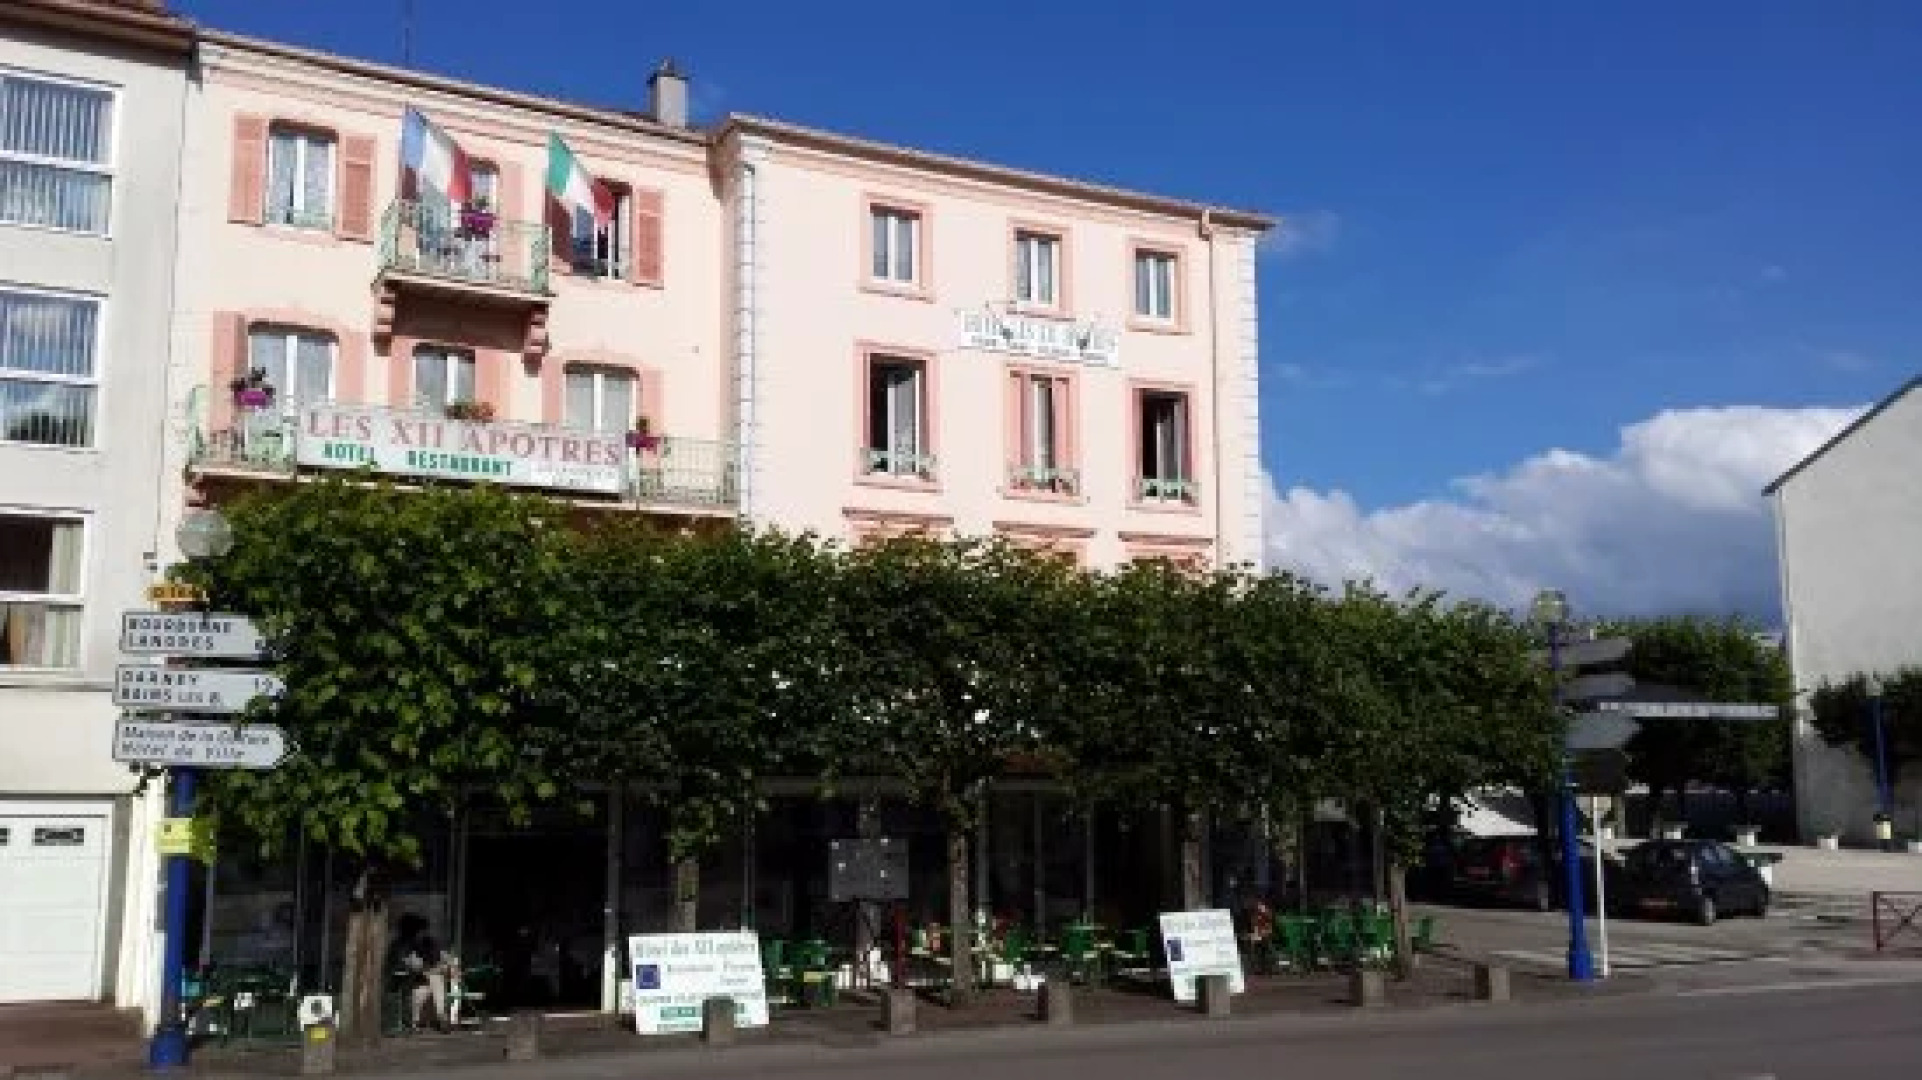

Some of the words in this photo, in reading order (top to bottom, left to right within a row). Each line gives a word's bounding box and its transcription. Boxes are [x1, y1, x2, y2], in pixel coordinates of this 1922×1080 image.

[306, 412, 372, 440] LES
[391, 419, 444, 448] XII
[459, 428, 621, 465] APOTRES
[407, 450, 513, 476] RESTAURANT
[122, 670, 200, 685] DARNEY
